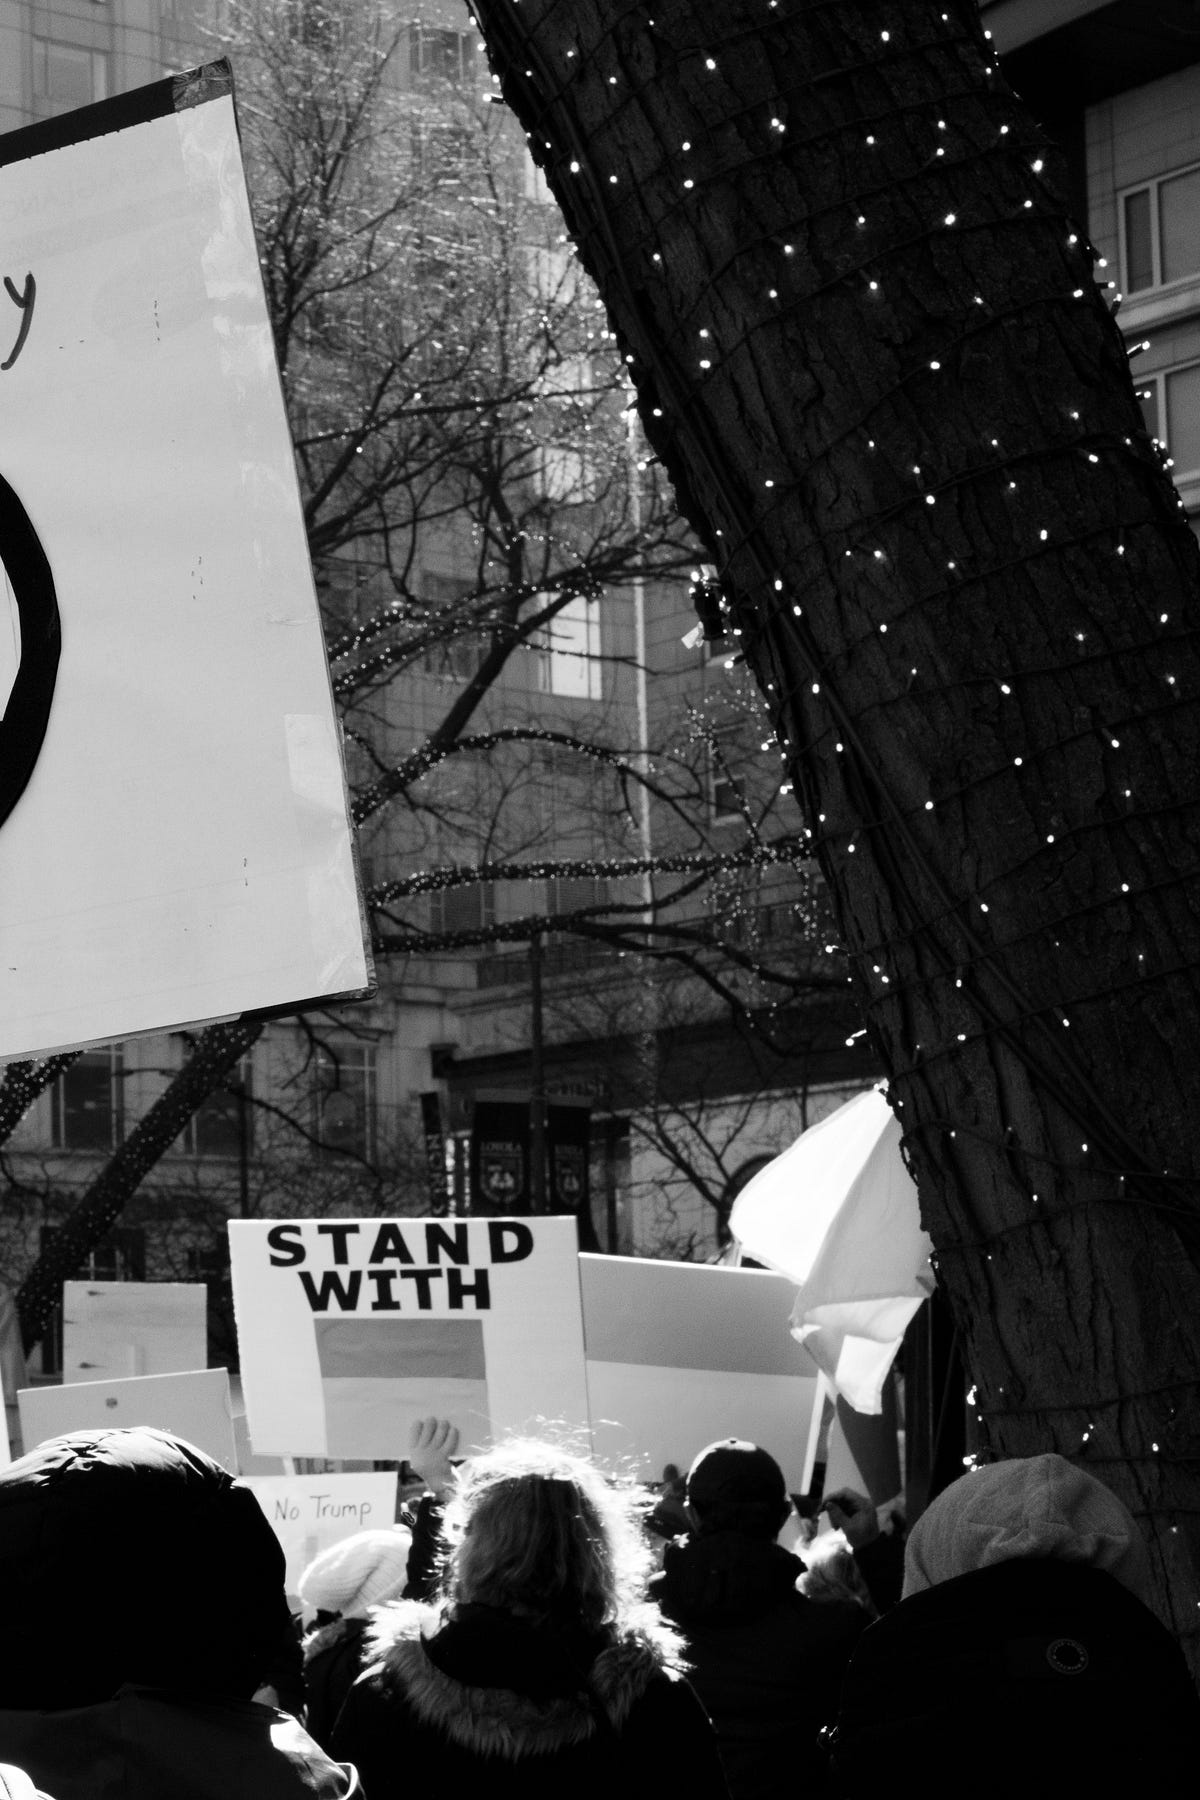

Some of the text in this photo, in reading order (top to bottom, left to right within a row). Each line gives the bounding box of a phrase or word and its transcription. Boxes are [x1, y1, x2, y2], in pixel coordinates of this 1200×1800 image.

[267, 1221, 534, 1267] STAND
[297, 1268, 491, 1312] WITH
[274, 1494, 372, 1526] No Trump
